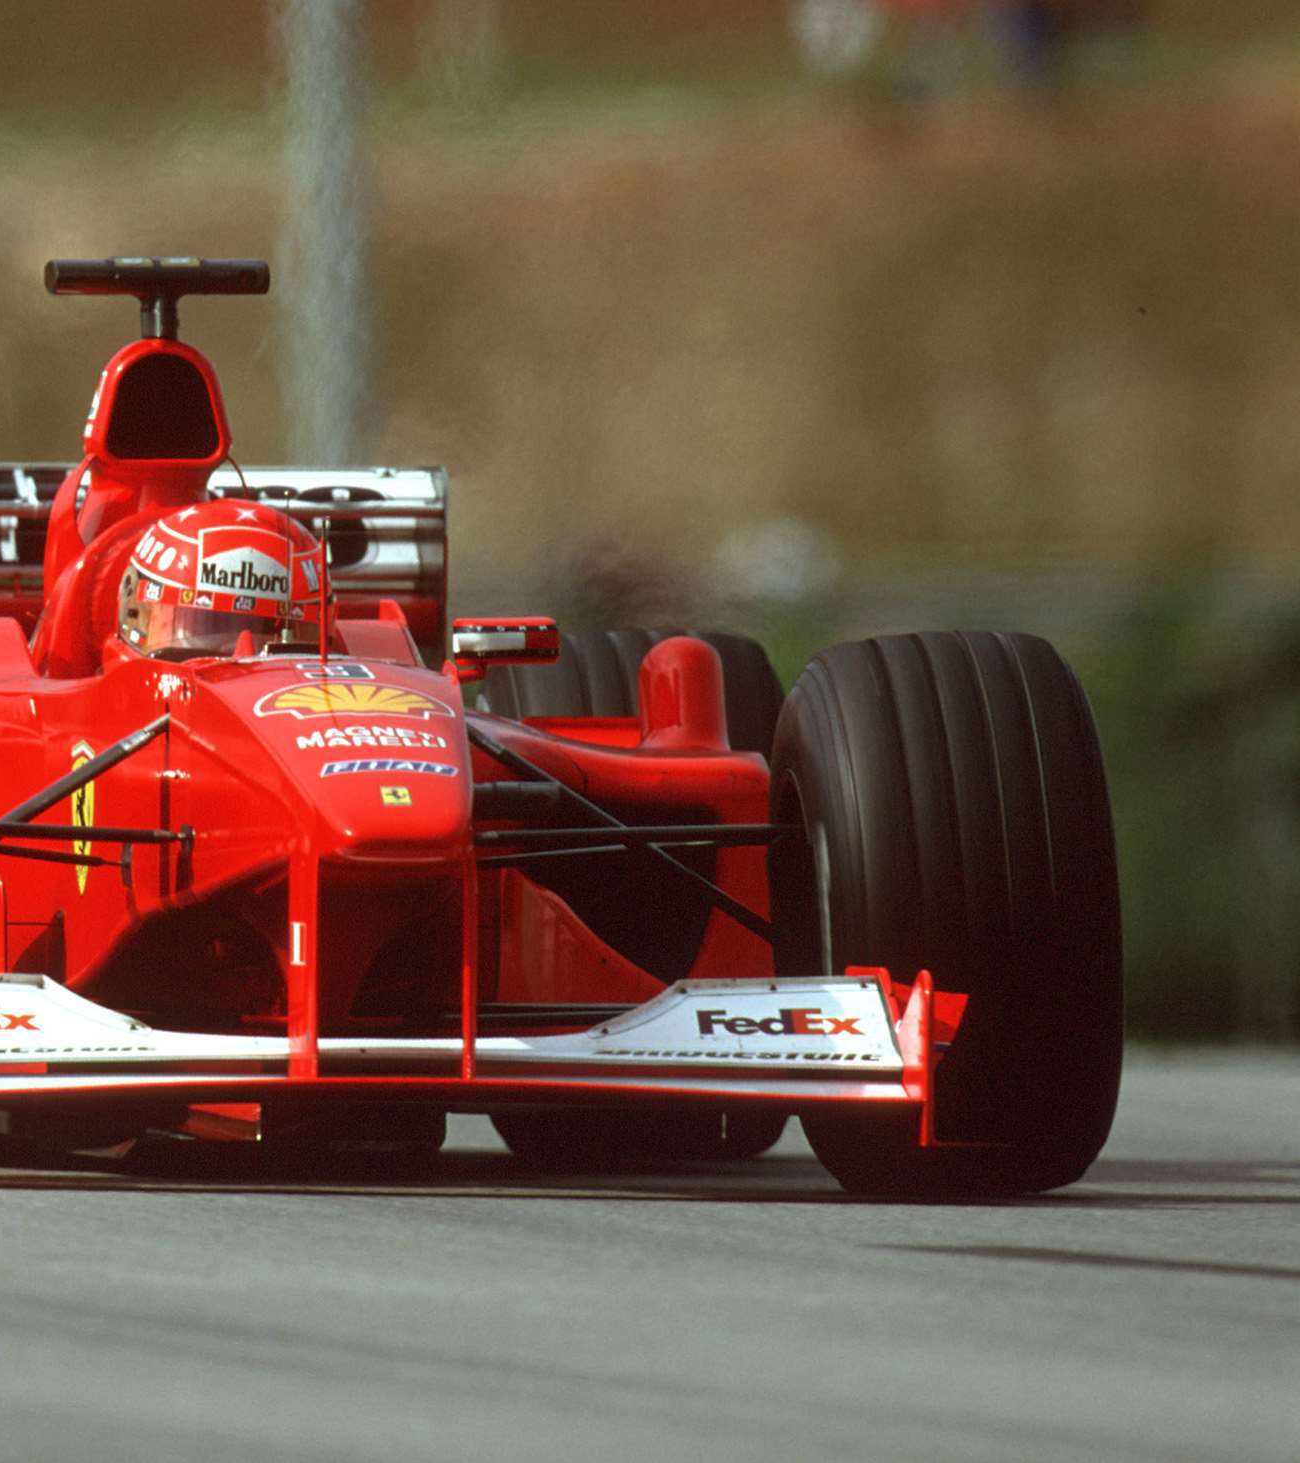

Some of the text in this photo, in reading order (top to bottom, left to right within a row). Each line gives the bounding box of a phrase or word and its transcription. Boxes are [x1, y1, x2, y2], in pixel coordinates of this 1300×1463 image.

[200, 561, 289, 593] Marlboro
[296, 734, 446, 749] MARELLI
[697, 1008, 865, 1035] FedEx
